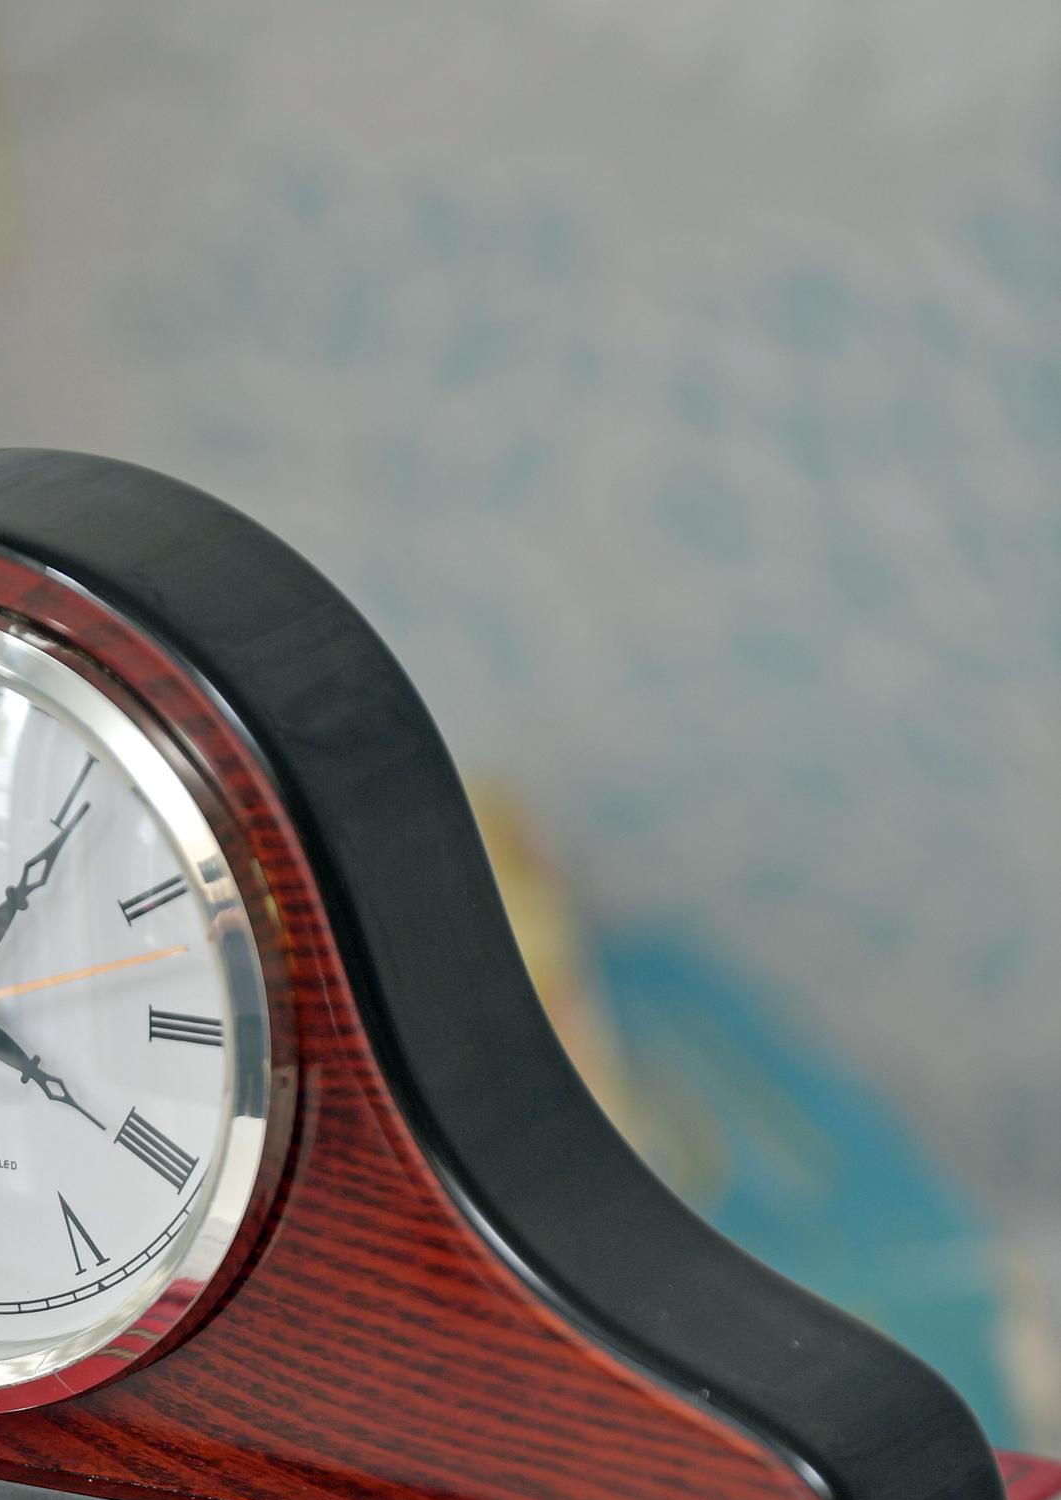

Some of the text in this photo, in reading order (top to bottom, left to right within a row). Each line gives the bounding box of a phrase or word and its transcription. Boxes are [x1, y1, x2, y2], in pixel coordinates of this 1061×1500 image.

[118, 872, 189, 926] II
[149, 1004, 224, 1047] III
[114, 1106, 200, 1195] IIII
[58, 1191, 111, 1275] V
